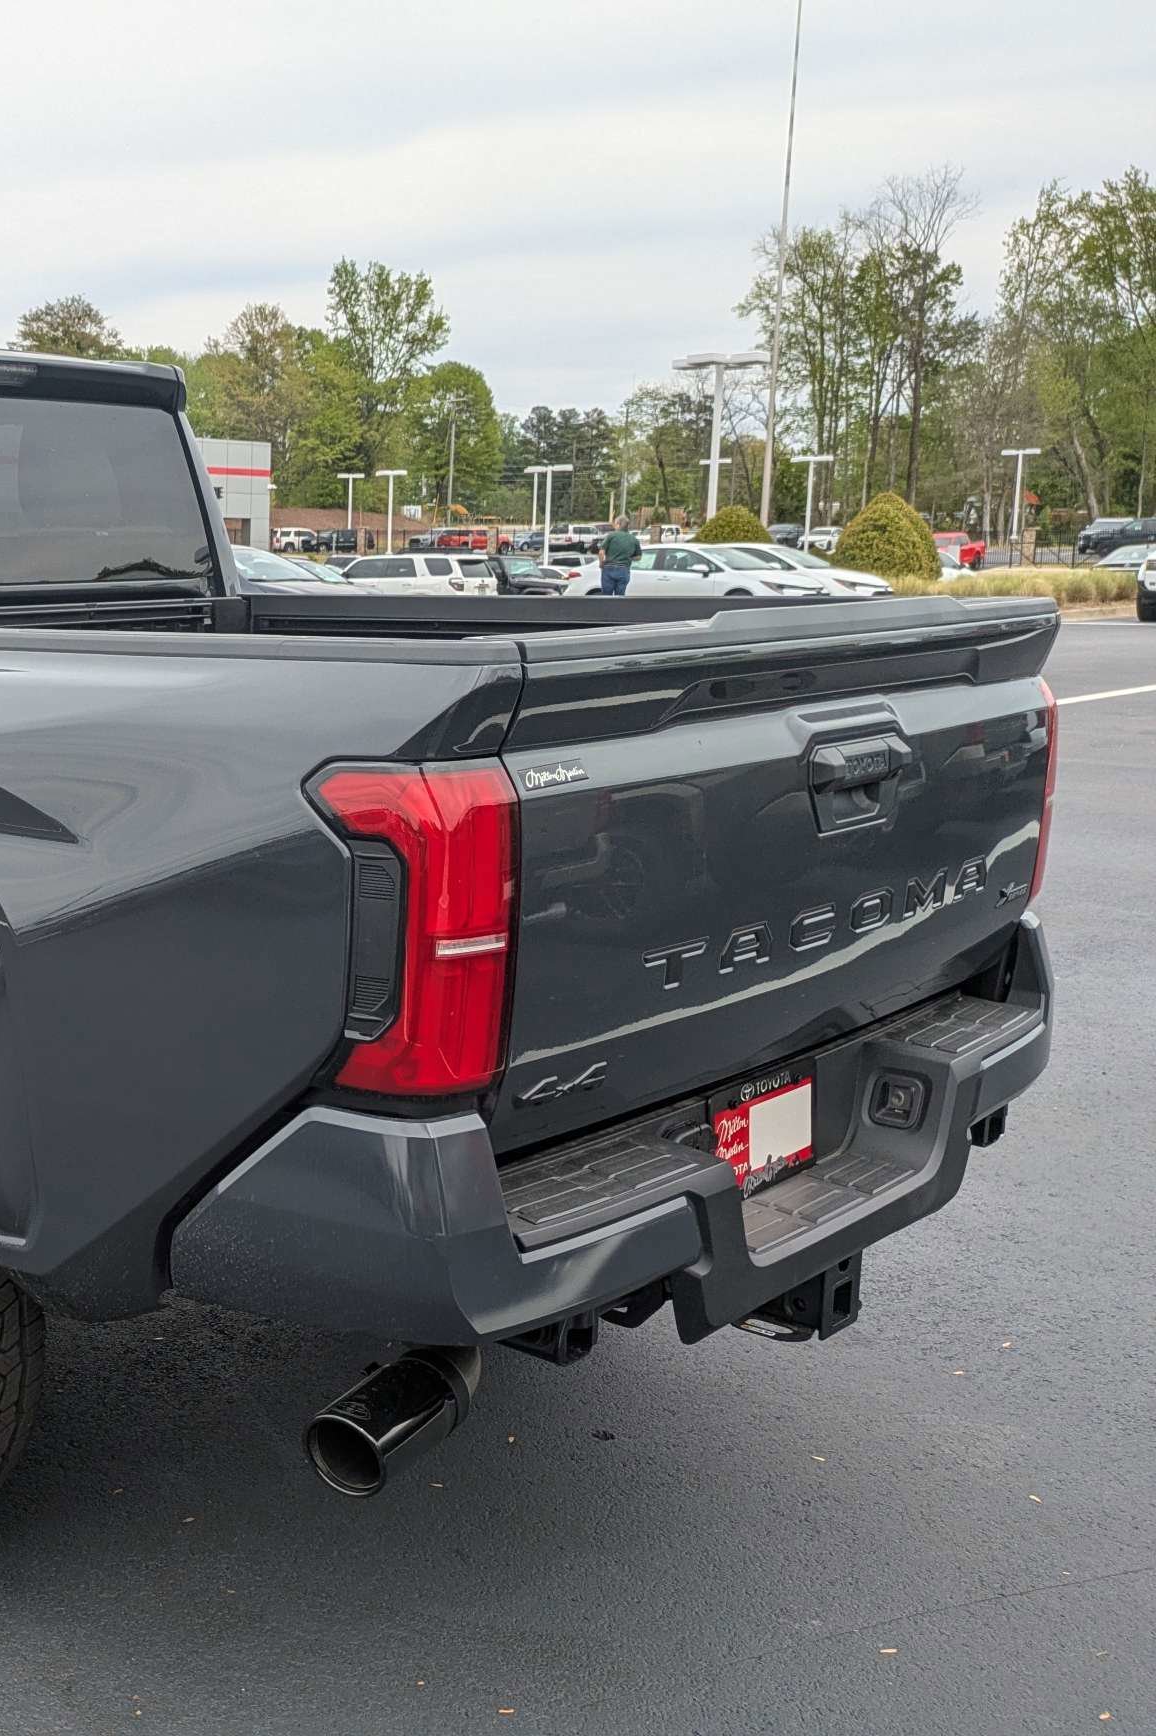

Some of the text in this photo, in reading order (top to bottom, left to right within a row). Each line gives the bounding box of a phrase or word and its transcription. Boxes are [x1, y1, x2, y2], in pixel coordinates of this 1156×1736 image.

[643, 854, 989, 991] TACOMA
[755, 1071, 792, 1095] TOYOTA
[716, 1116, 749, 1147] Milton
[716, 1142, 749, 1160] Martin
